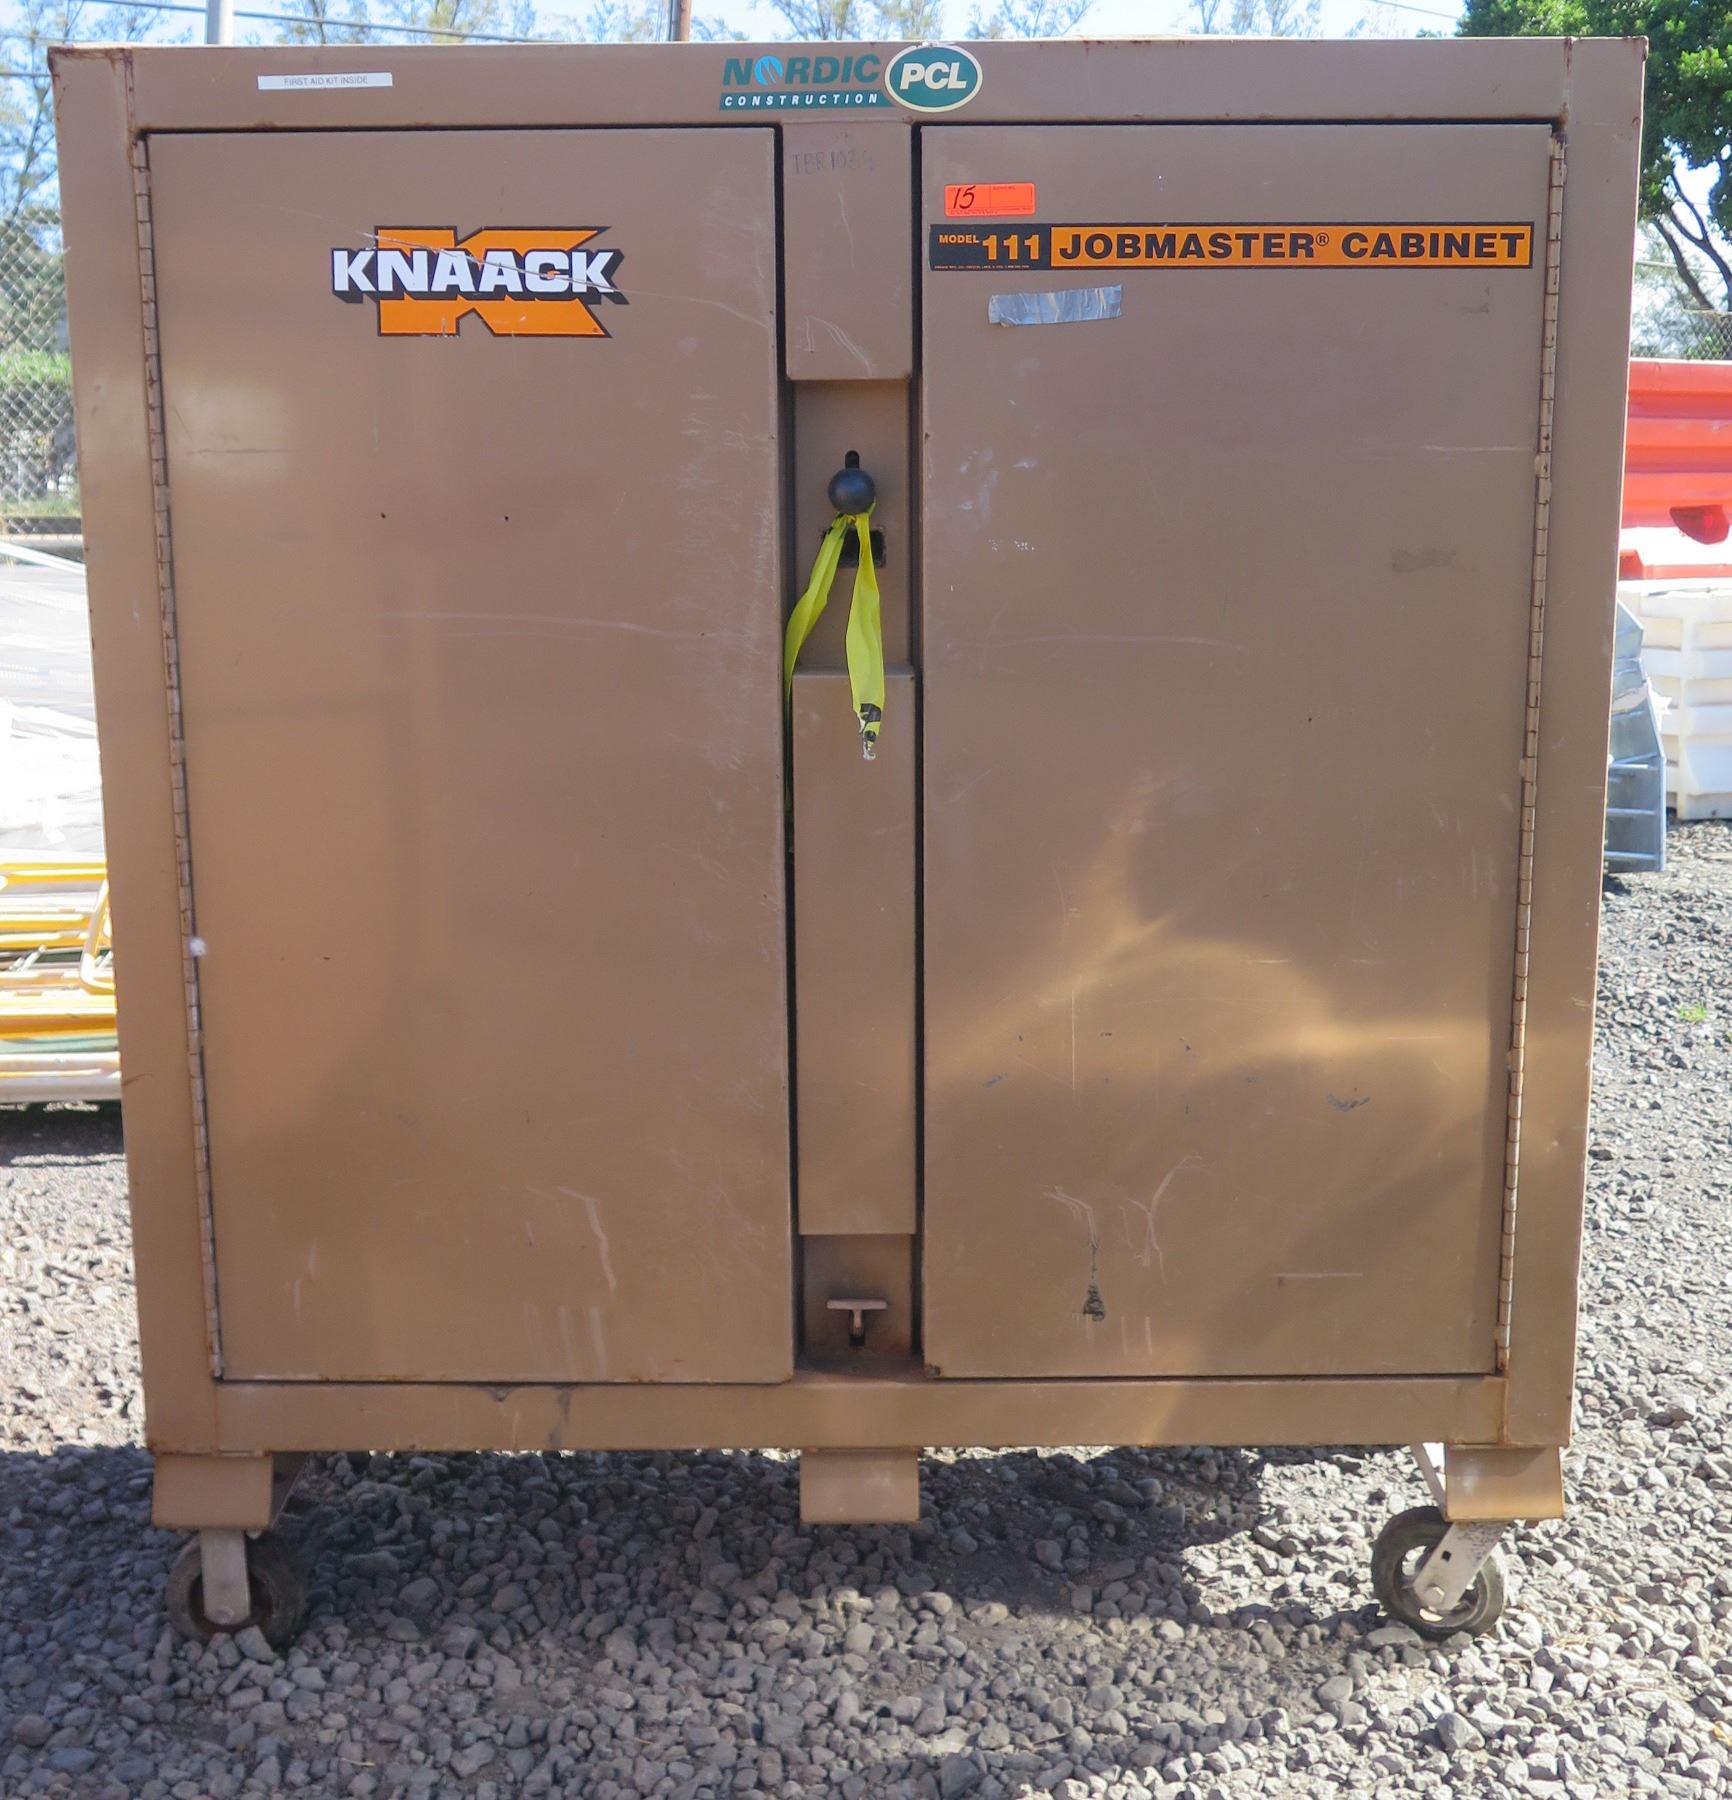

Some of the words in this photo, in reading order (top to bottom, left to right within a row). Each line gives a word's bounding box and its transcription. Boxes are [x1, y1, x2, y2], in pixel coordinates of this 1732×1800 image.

[284, 77, 308, 87] FIRST
[310, 77, 325, 86] AID
[326, 77, 338, 86] KIT
[340, 76, 368, 85] INSIDE
[722, 54, 881, 86] NORDIC
[899, 62, 968, 90] PCL
[724, 93, 878, 107] CONSTRUCTION
[952, 185, 976, 210] 15
[938, 234, 980, 244] MODEL
[982, 234, 1041, 260] 111
[1341, 232, 1525, 258] CABINET
[332, 248, 616, 294] KNAACK
